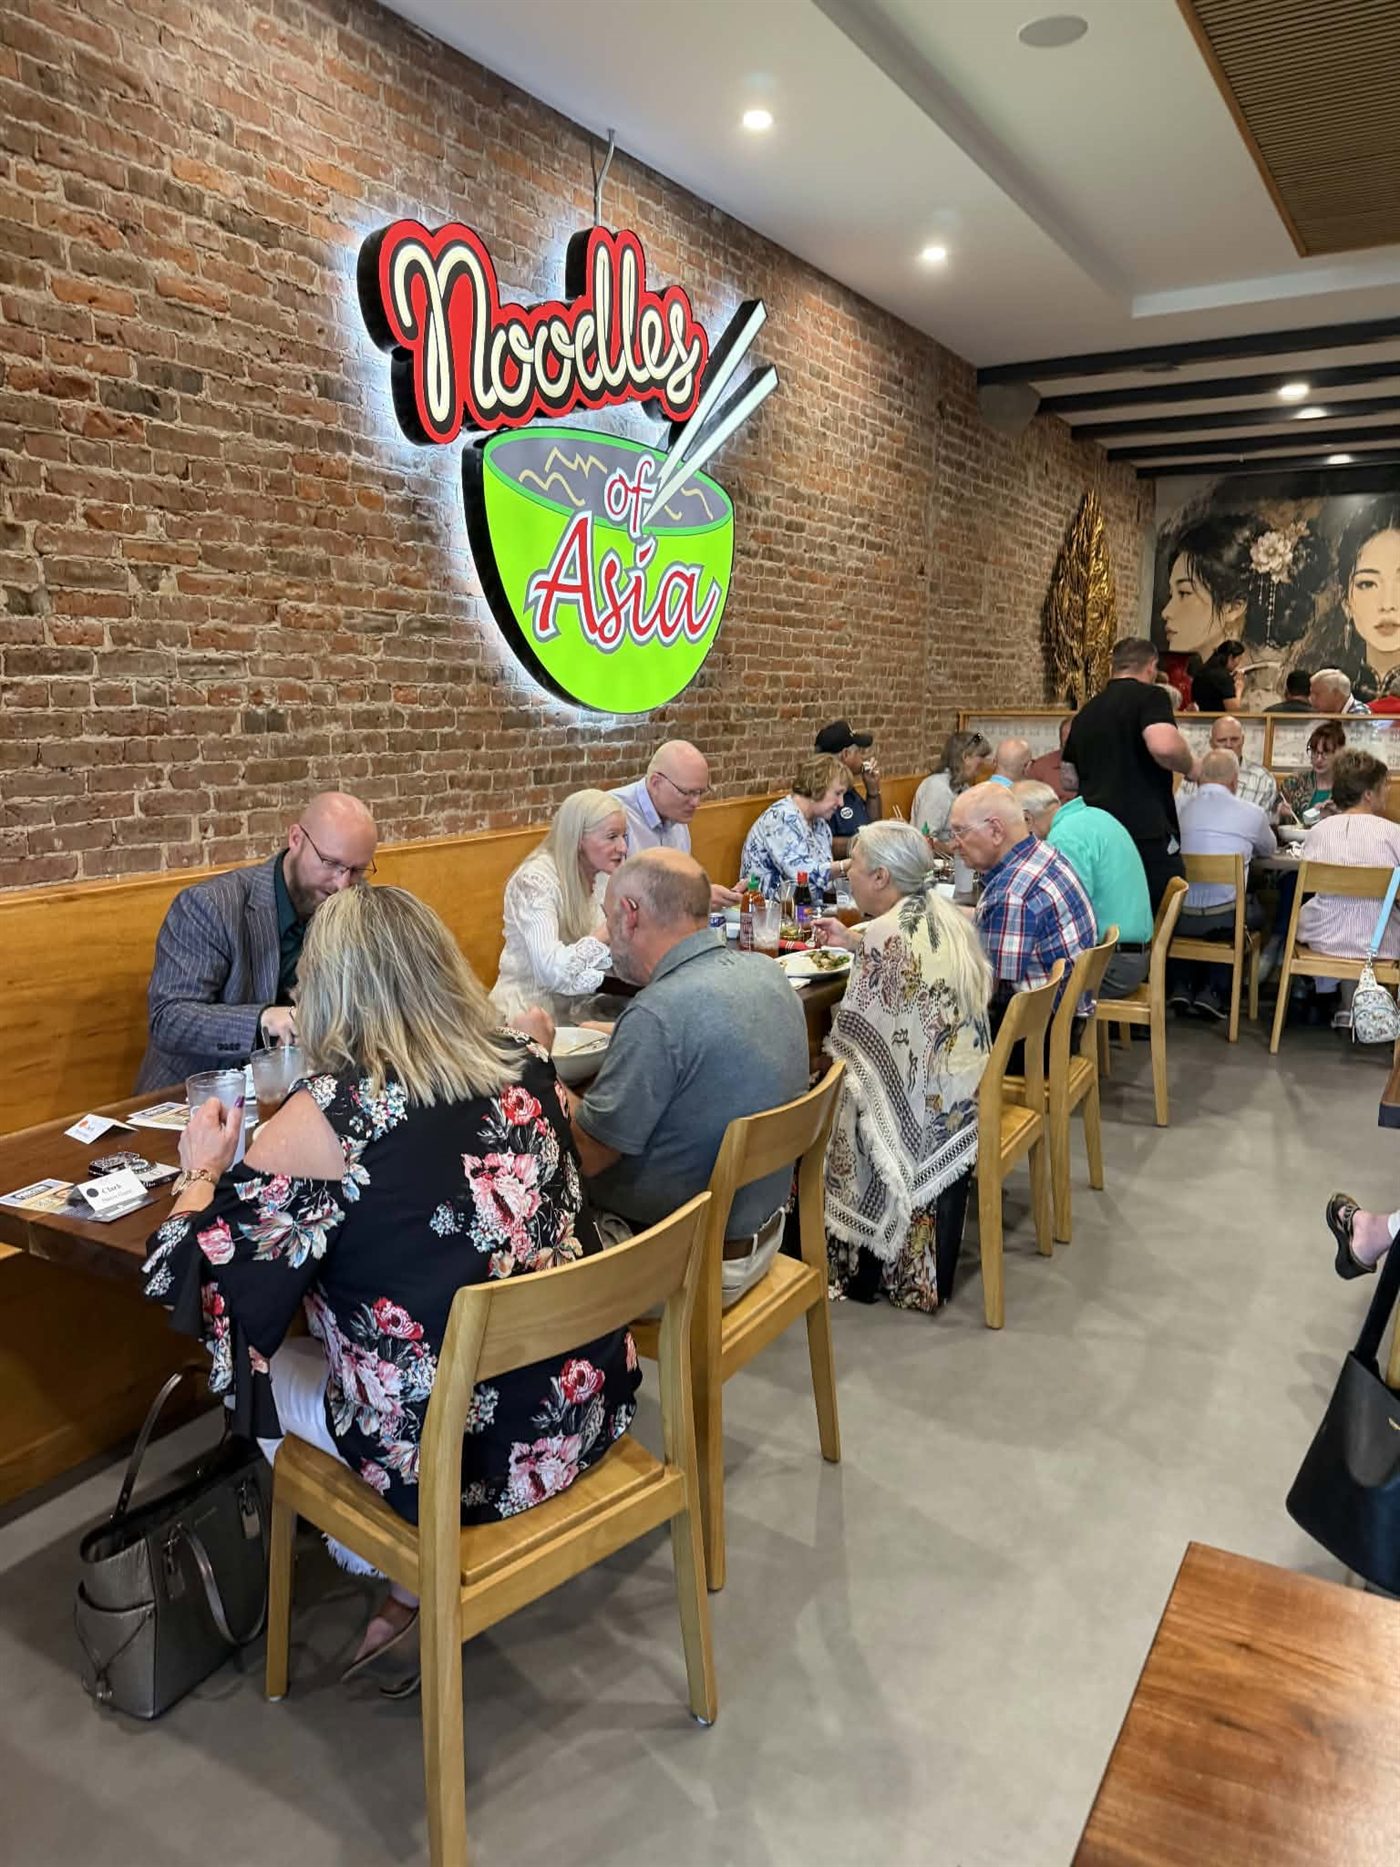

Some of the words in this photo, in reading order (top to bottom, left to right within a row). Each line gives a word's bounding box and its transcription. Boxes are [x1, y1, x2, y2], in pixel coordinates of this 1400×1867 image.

[390, 240, 702, 425] Noodles
[605, 456, 661, 536] of
[529, 512, 721, 648] Asia
